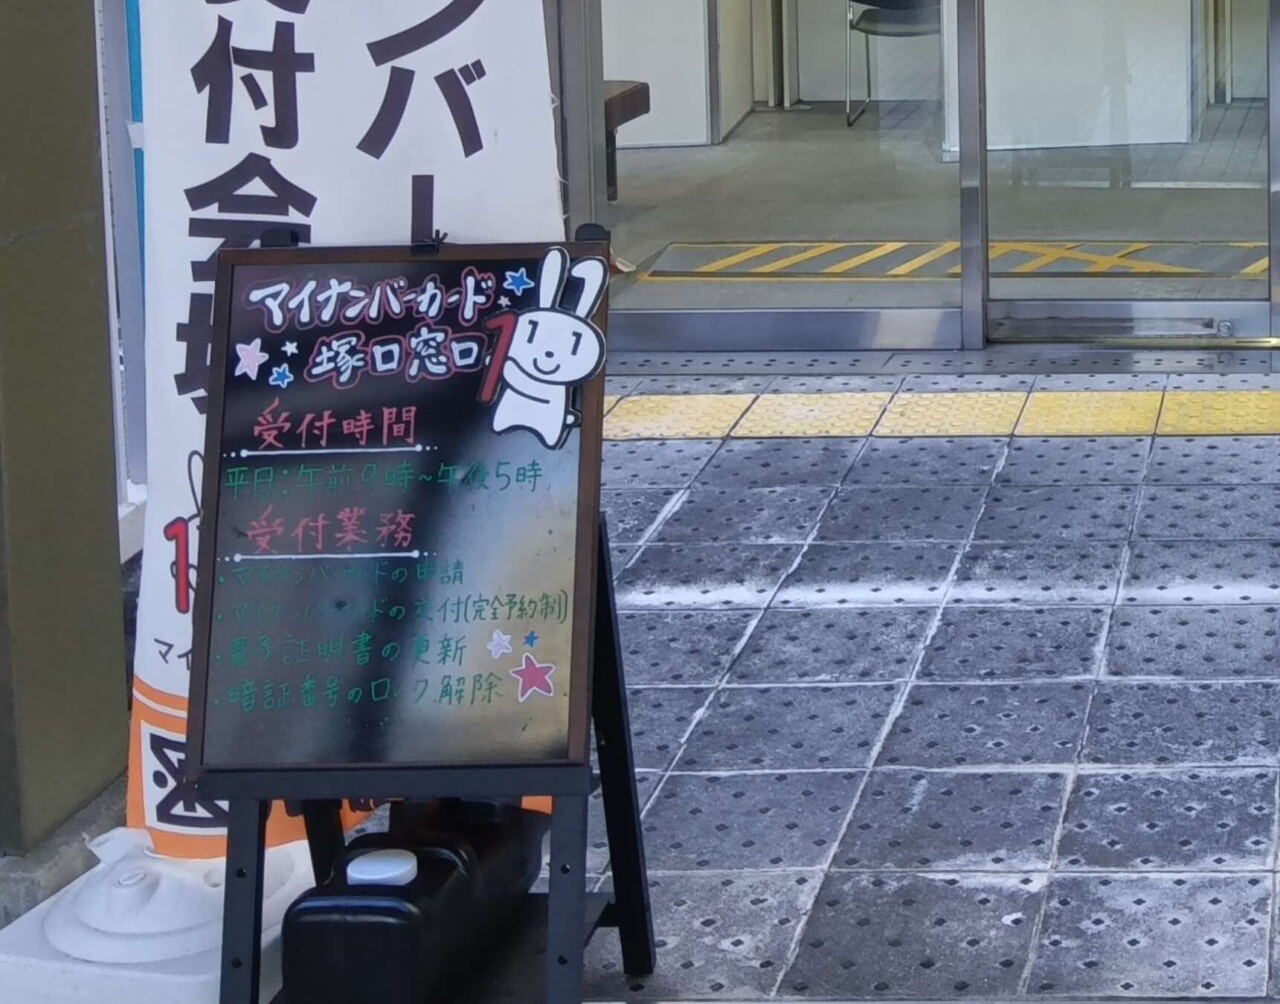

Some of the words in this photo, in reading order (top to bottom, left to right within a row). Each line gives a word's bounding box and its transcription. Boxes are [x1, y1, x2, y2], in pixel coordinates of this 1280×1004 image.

[248, 272, 496, 327] マイナンバーカード
[309, 326, 480, 384] 塚口窓口
[253, 398, 418, 449] 受付時間
[247, 505, 416, 554] 受付業務
